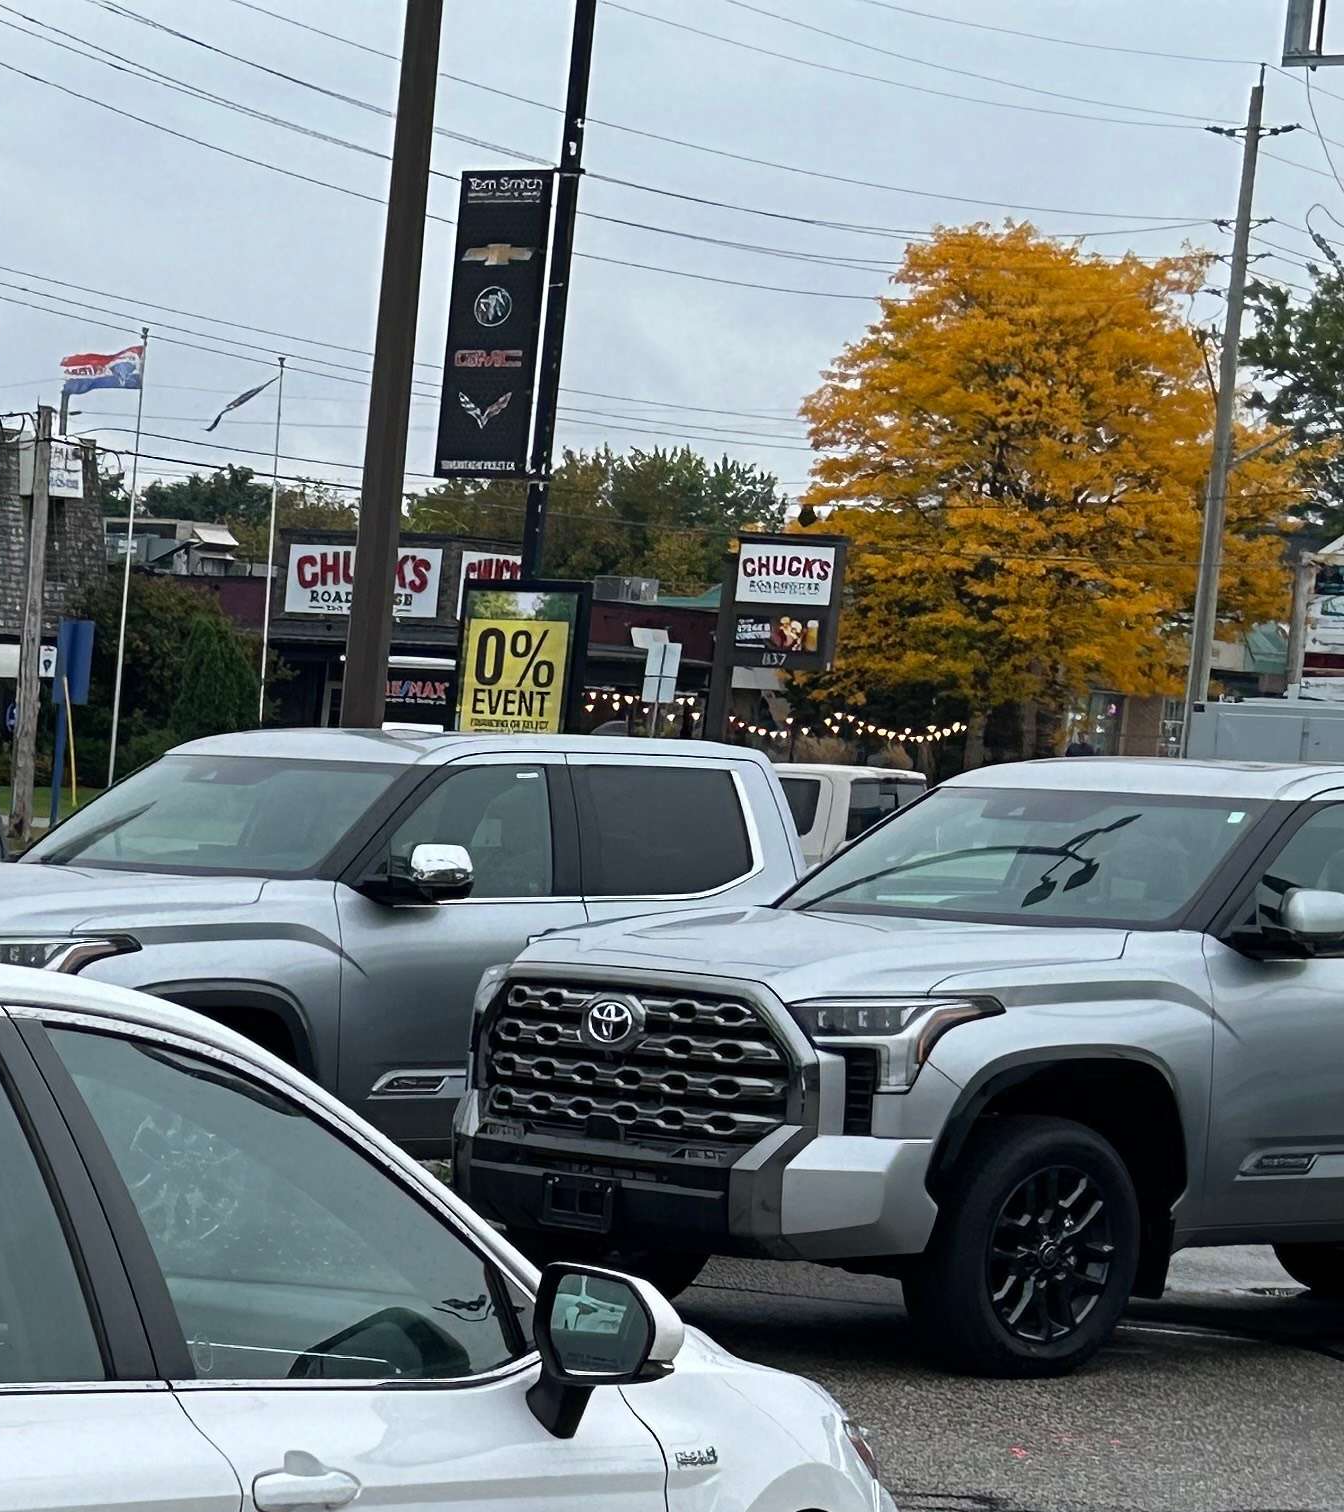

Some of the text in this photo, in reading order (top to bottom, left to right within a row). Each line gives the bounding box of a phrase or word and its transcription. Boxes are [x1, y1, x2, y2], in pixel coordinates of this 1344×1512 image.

[296, 550, 432, 594] CHUK'S
[742, 555, 832, 581] CHUCK'S
[474, 627, 555, 689] 0%
[471, 688, 553, 717] EVENT
